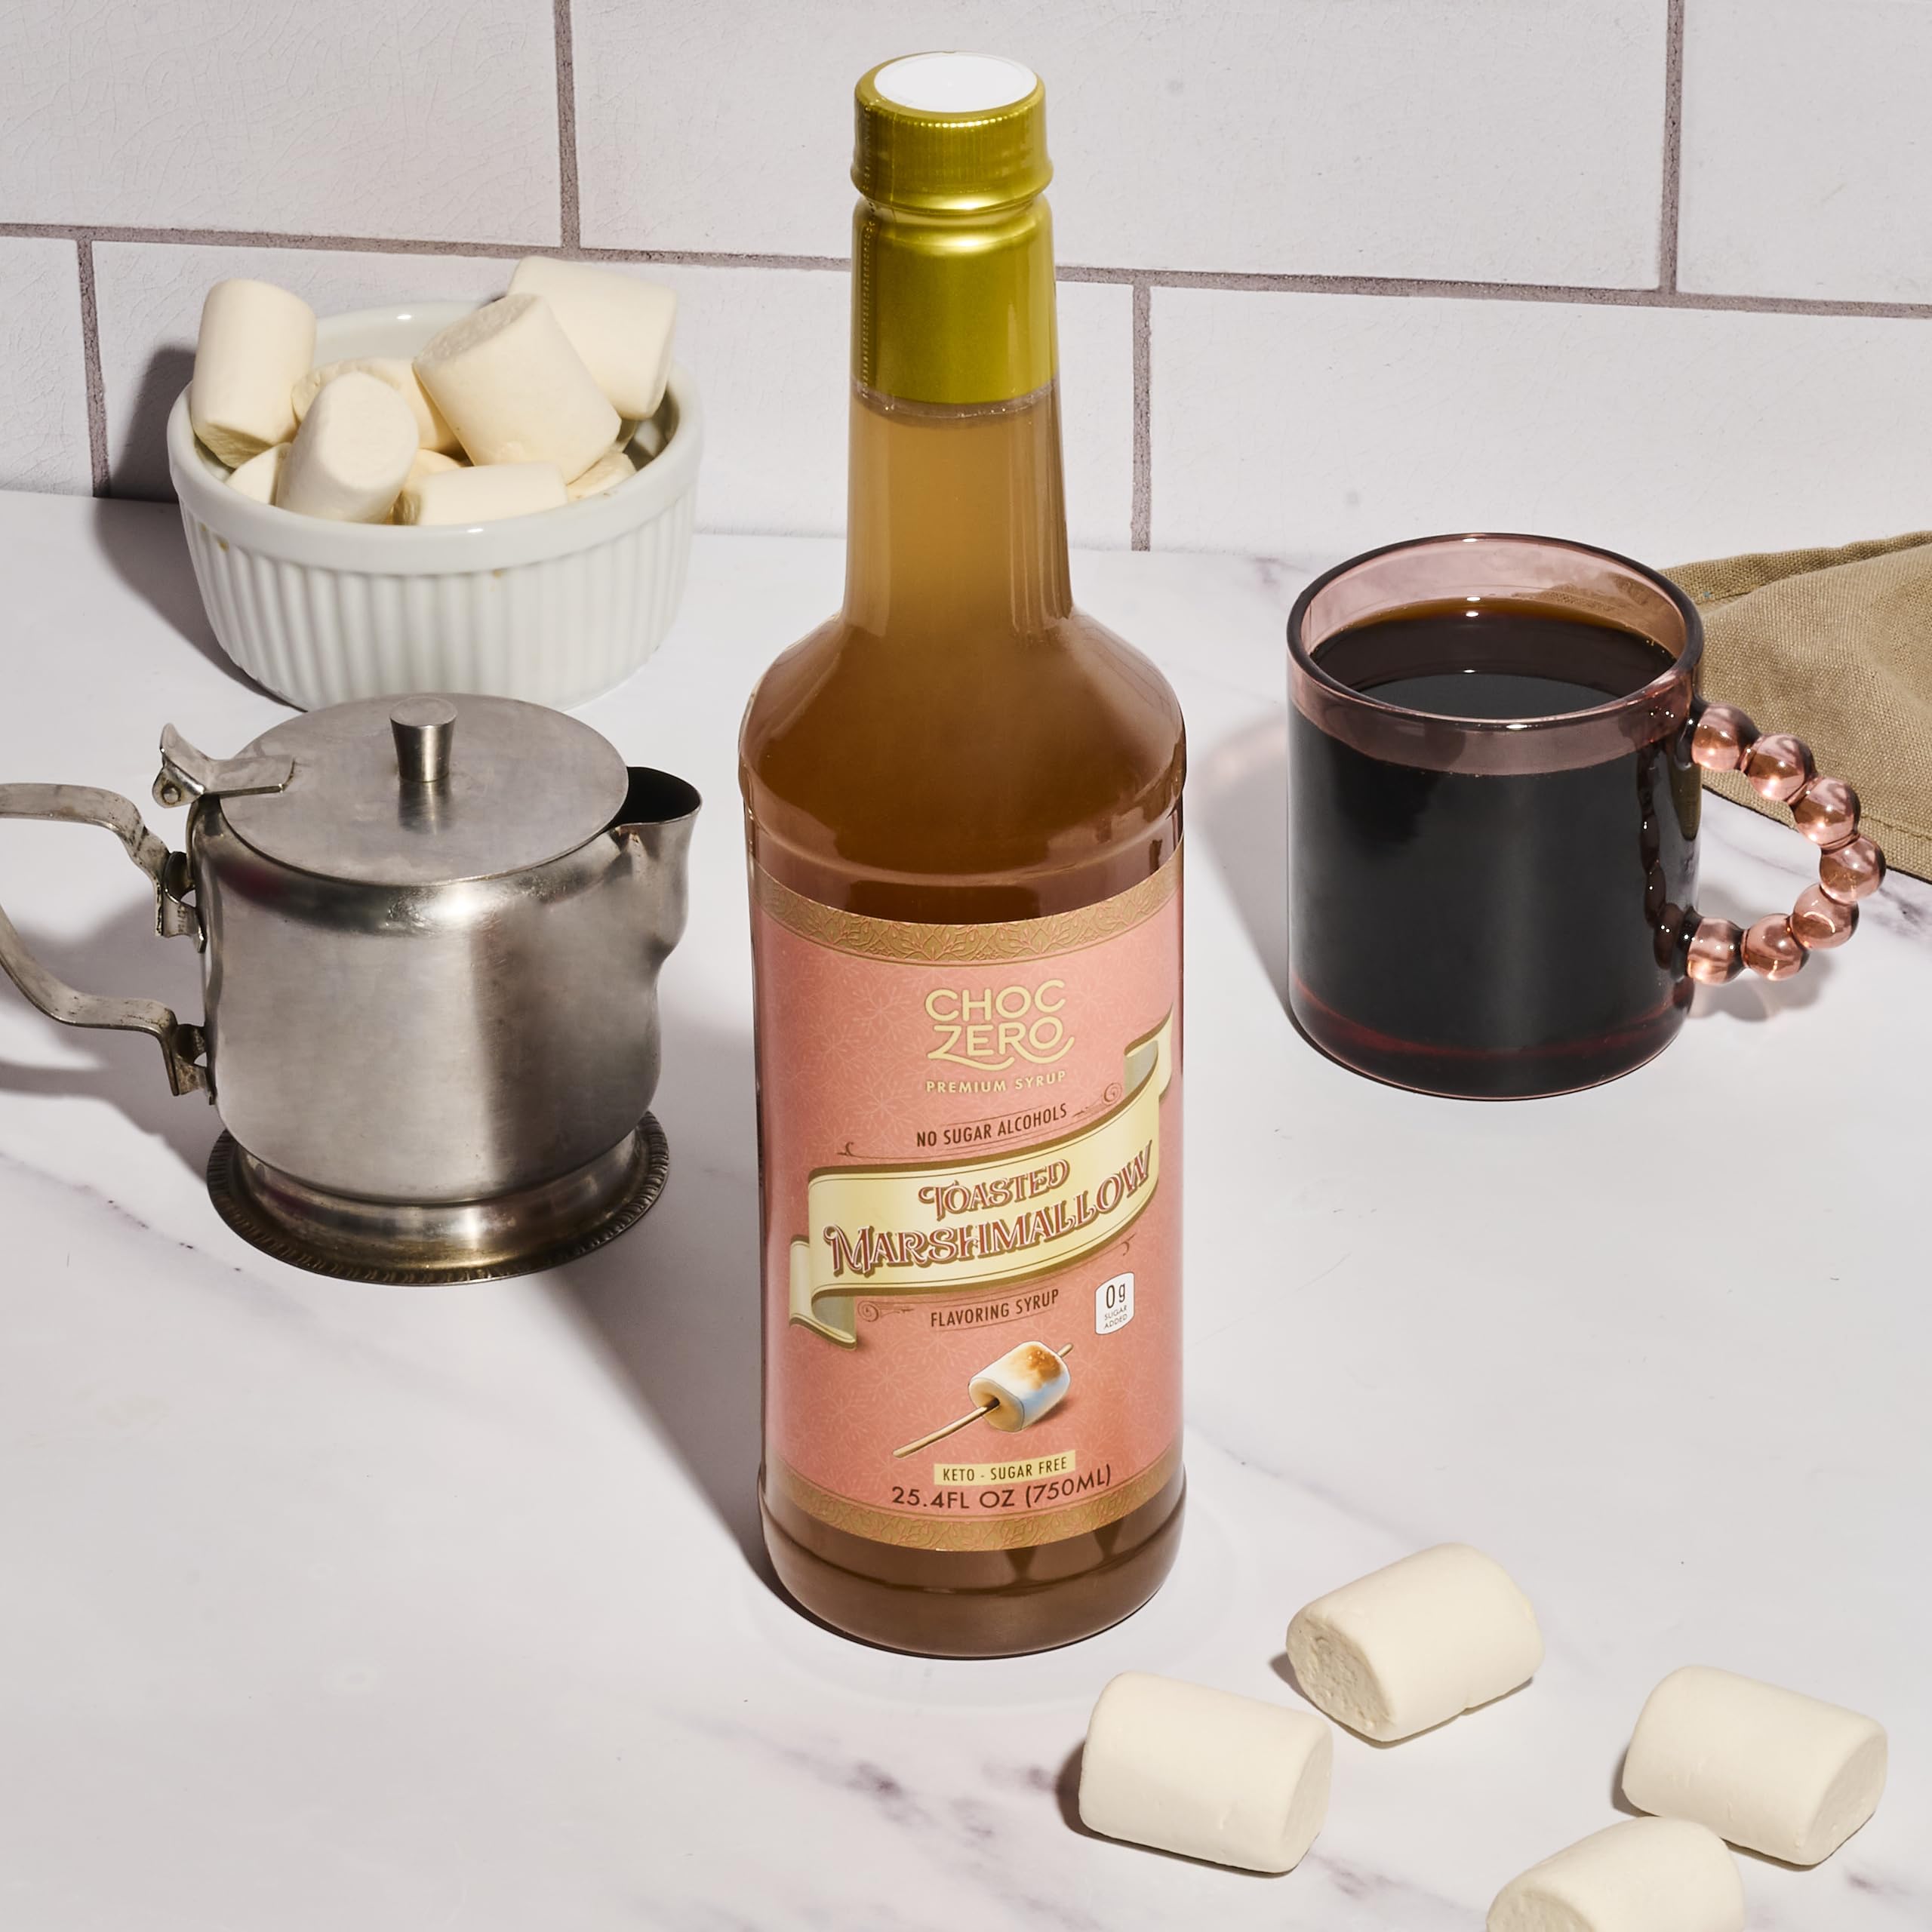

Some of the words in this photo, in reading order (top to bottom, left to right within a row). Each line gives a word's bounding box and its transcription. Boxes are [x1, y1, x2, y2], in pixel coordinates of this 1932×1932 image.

[924, 979, 1064, 1020] CHOC
[927, 1016, 1074, 1069] ZERO
[926, 1080, 1005, 1092] PREMIUM
[1015, 1070, 1065, 1089] SYRUP
[916, 1131, 936, 1146] NO
[943, 1124, 991, 1143] SUGAR
[998, 1103, 1066, 1137] ALCOHOLS
[823, 1139, 1152, 1276] MARSHMALLOW
[918, 1158, 1069, 1219] TOASTED
[931, 1305, 1008, 1327] FLAVORING
[1016, 1288, 1058, 1313] SYRUP
[1103, 1313, 1128, 1330] ADDED
[1104, 1305, 1128, 1321] SUGAR
[891, 1485, 969, 1508] 25.4FL
[979, 1488, 1014, 1508] OZ
[1025, 1463, 1111, 1507] (750ML)
[942, 1467, 974, 1481] KETO
[990, 1462, 1032, 1479] SUGAR
[1038, 1456, 1066, 1474] FREE
